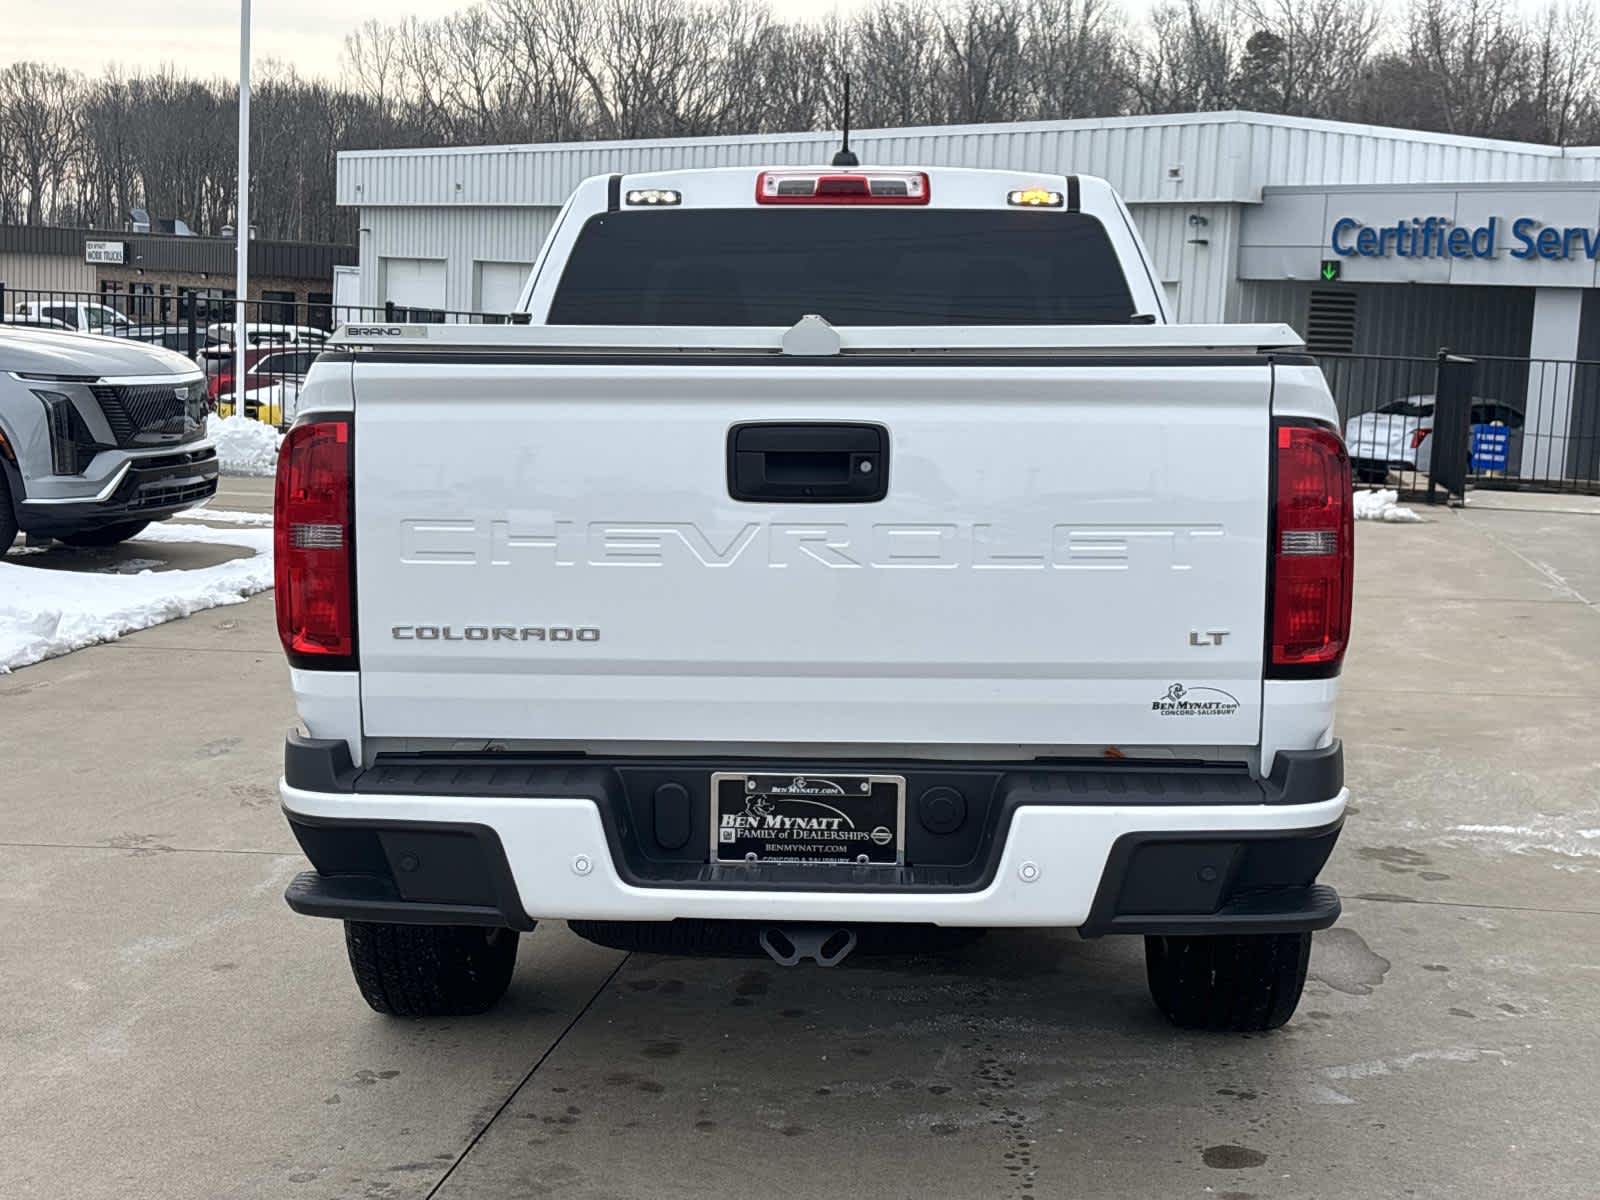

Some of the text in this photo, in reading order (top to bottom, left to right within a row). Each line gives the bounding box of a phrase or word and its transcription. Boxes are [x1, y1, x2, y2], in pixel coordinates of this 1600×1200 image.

[1331, 216, 1496, 259] Certified
[348, 327, 401, 336] BRAND
[400, 519, 1224, 570] CHEVROLET
[392, 626, 601, 642] COLORADO
[1189, 631, 1230, 646] LT
[1152, 702, 1175, 710] BEN
[720, 814, 842, 829] BEN MYNATT
[736, 828, 777, 839] FAMILY
[793, 829, 870, 840] DEALERSHIPS
[765, 844, 847, 853] BENMYNATT.COM
